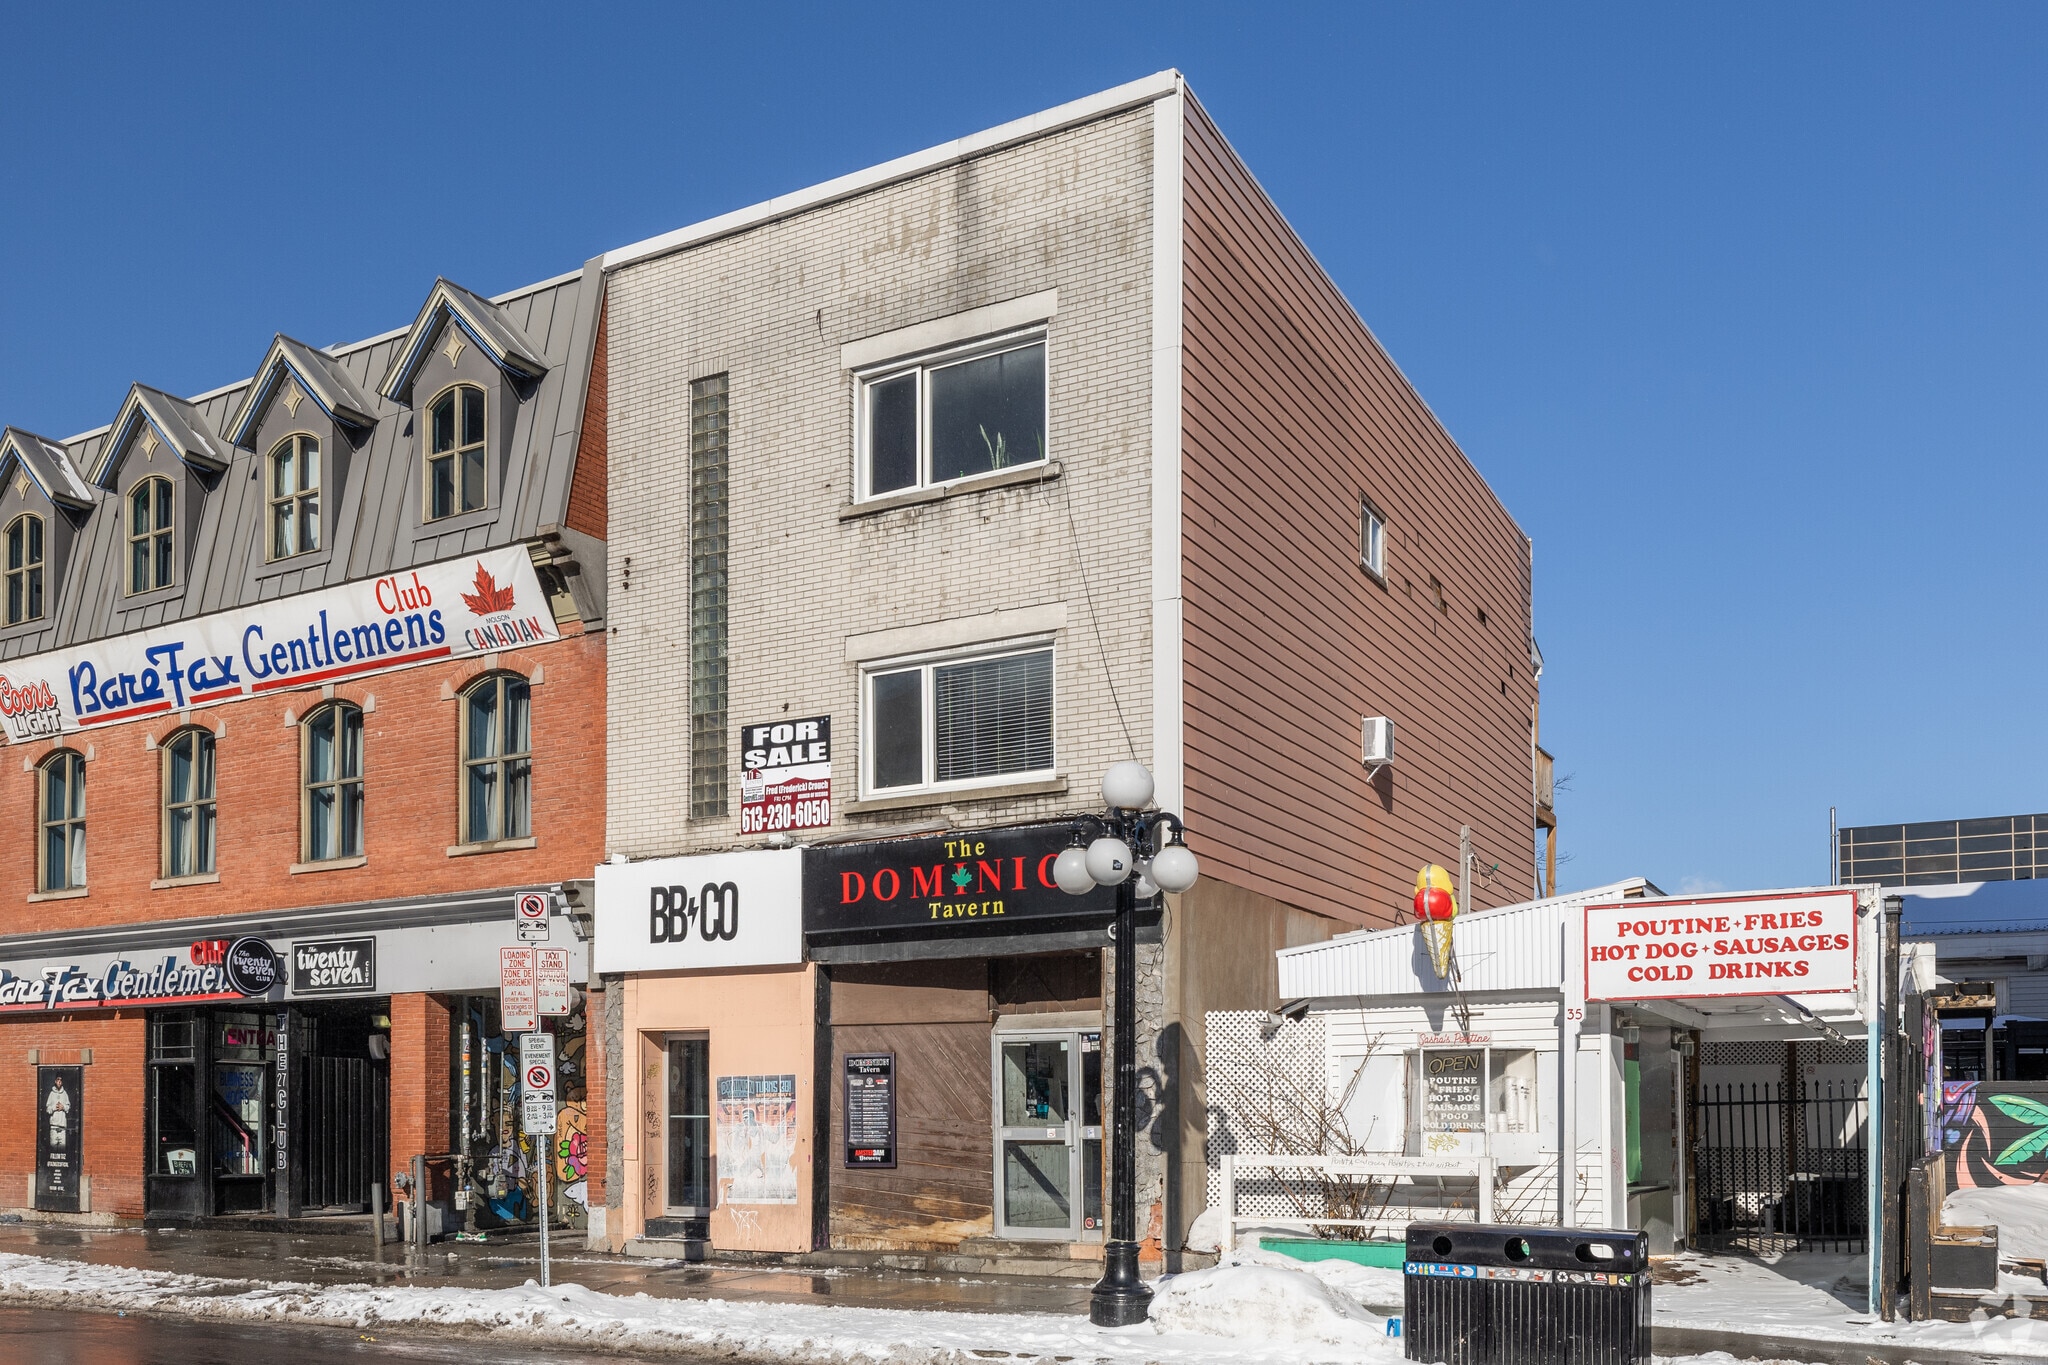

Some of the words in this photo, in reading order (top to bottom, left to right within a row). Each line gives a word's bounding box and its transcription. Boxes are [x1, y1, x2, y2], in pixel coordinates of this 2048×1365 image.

[375, 571, 432, 615] Club
[485, 614, 510, 624] MOLSON
[464, 616, 545, 650] CANADIAN
[242, 609, 446, 679] Gentlemens
[0, 674, 58, 717] Coors
[11, 706, 62, 739] LIGHT
[752, 721, 819, 747] FOR
[744, 741, 828, 769] SALE
[765, 786, 778, 795] Fred
[808, 780, 829, 791] Crouch
[742, 799, 830, 833] 613-230-6050
[944, 840, 986, 860] The
[839, 852, 1059, 905] DOMINIO
[928, 899, 1005, 920] Tavern
[1617, 916, 1731, 938] POUTINE
[1743, 910, 1824, 931] FRIES
[503, 951, 531, 960] LOADING
[1590, 944, 1640, 962] HOT
[1645, 941, 1698, 960] DOG
[1713, 933, 1850, 956] SAUSAGES
[233, 954, 272, 968] twenty
[296, 946, 358, 973] twenty
[508, 960, 526, 968] ZONE
[541, 960, 563, 968] STAND
[545, 952, 560, 960] TAXI
[242, 965, 275, 976] seven
[310, 965, 363, 986] seven
[503, 970, 520, 978] ZONE
[523, 970, 532, 978] DE
[538, 969, 565, 978] STATION
[1627, 964, 1694, 982] COLD
[1708, 960, 1810, 980] DRINKS
[503, 979, 532, 987] CHARGEMENT
[1567, 1008, 1583, 1020] 35
[277, 1013, 287, 1071] THE
[1419, 1032, 1451, 1047] Sasha's
[1453, 1031, 1491, 1044] Poutine
[848, 1058, 890, 1067] DOMINION
[858, 1066, 881, 1074] Tavern
[1428, 1053, 1481, 1074] OPEN
[219, 1071, 254, 1088] BUSINESS
[277, 1072, 287, 1087] 27
[755, 1080, 778, 1093] TURNS
[1429, 1077, 1478, 1085] POUTINE
[1438, 1085, 1470, 1094] FRIES
[1427, 1103, 1481, 1111] SAUSAGES
[277, 1089, 287, 1170] CLUB
[1423, 1122, 1448, 1130] COLD
[1449, 1122, 1486, 1130] DRINKS
